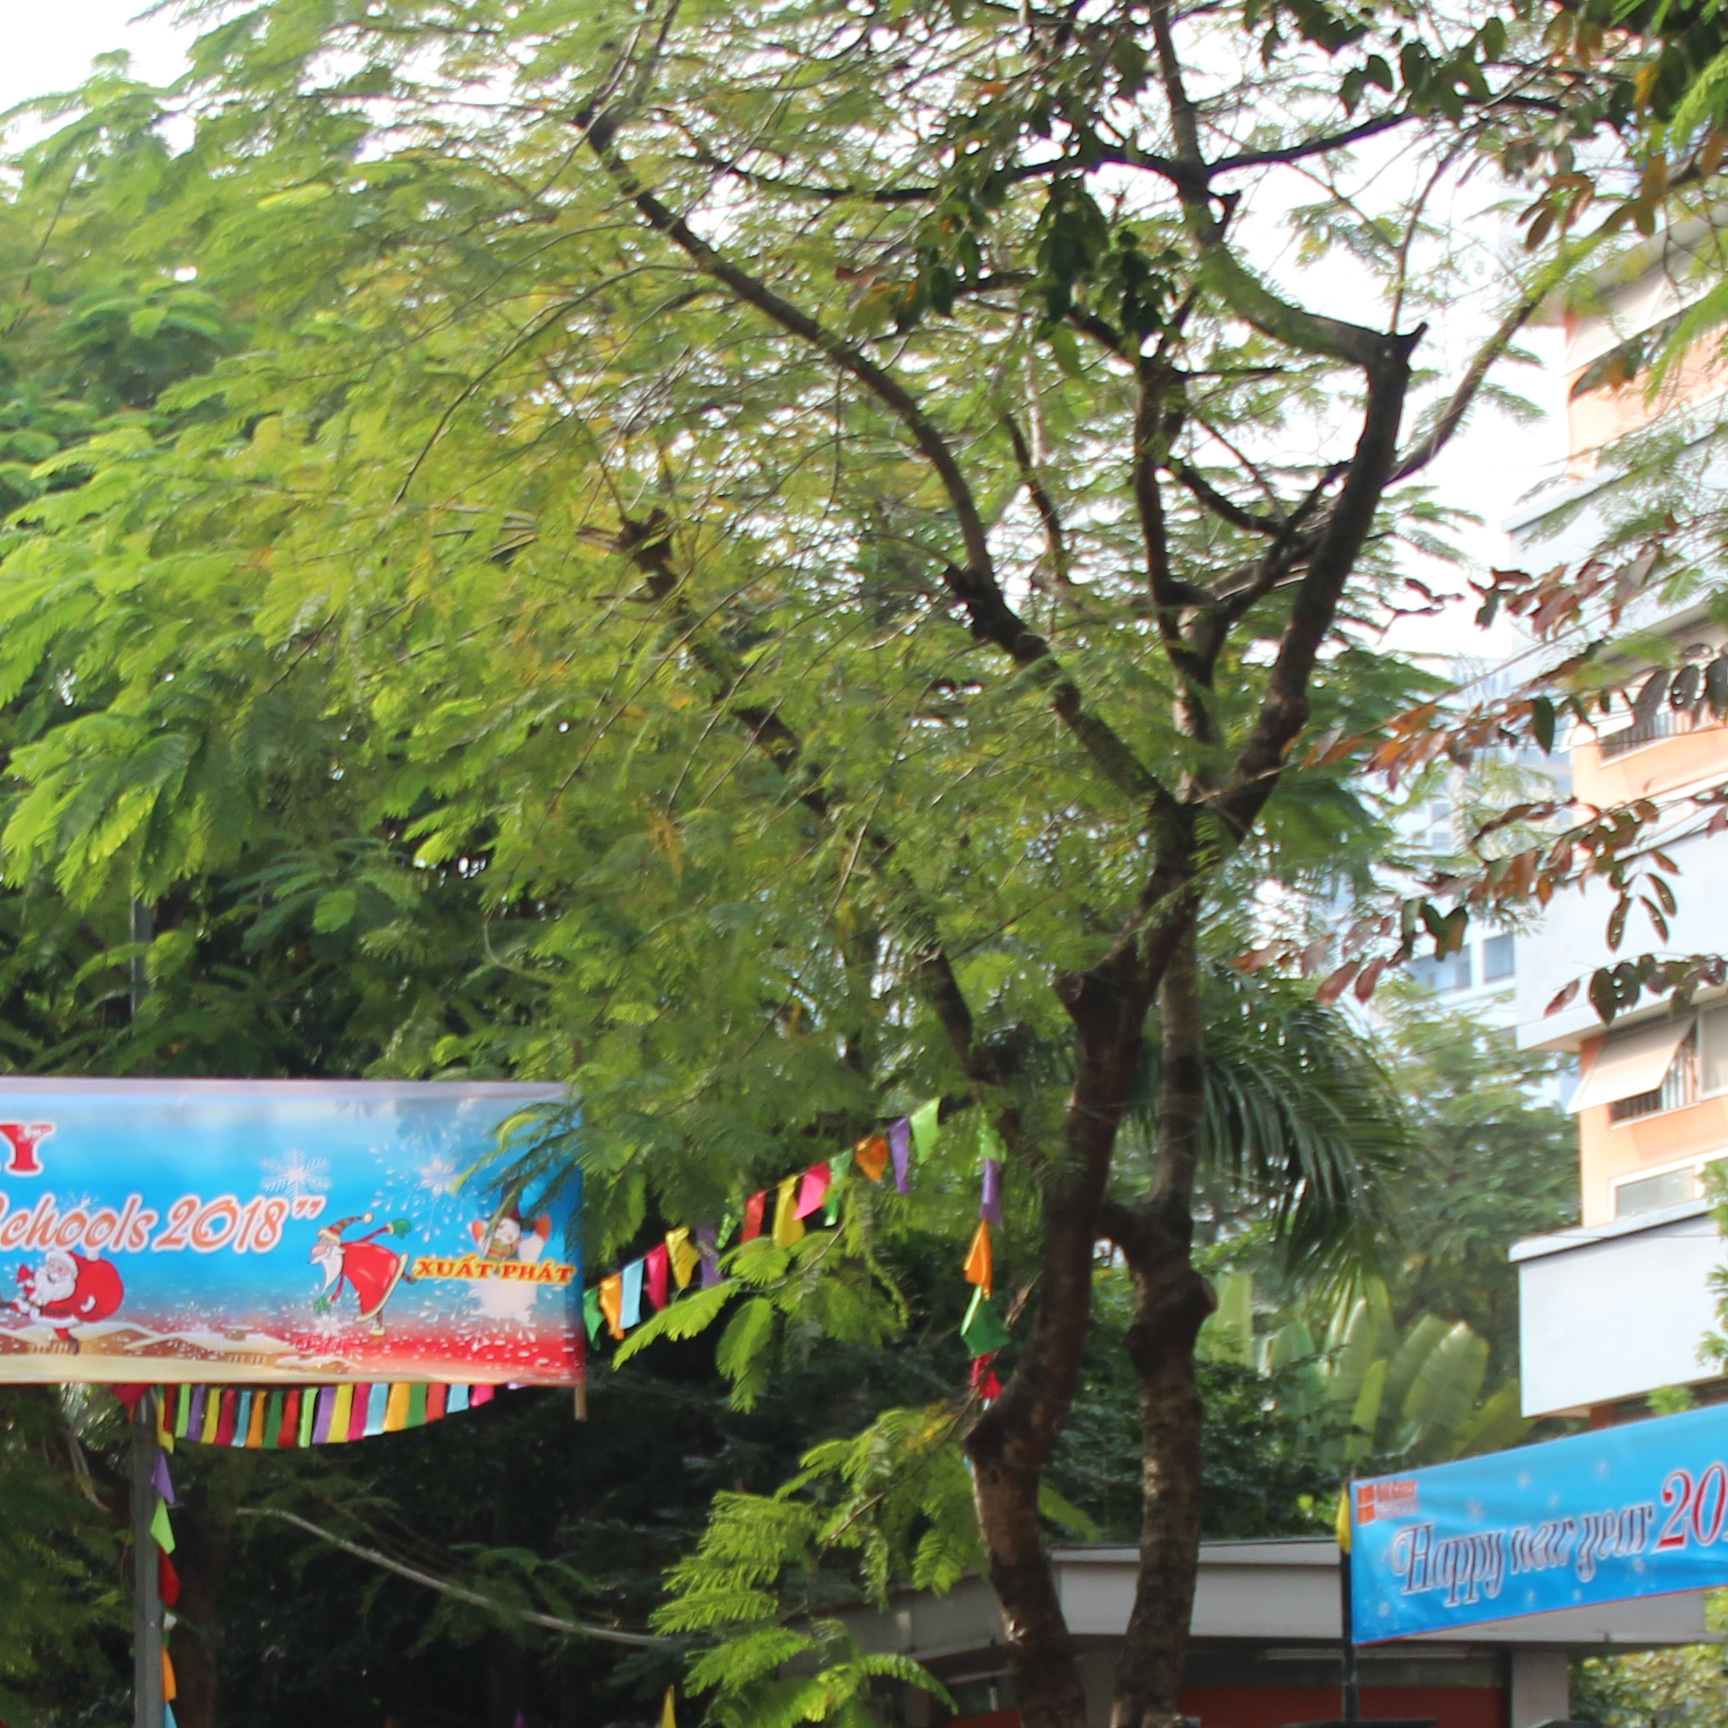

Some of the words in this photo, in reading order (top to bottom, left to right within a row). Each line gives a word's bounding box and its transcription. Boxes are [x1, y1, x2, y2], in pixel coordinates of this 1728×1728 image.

[414, 1254, 494, 1279] XUẤT
[500, 1259, 576, 1285] PHÁT
[1392, 1523, 1504, 1607] Happy
[1576, 1503, 1655, 1582] year
